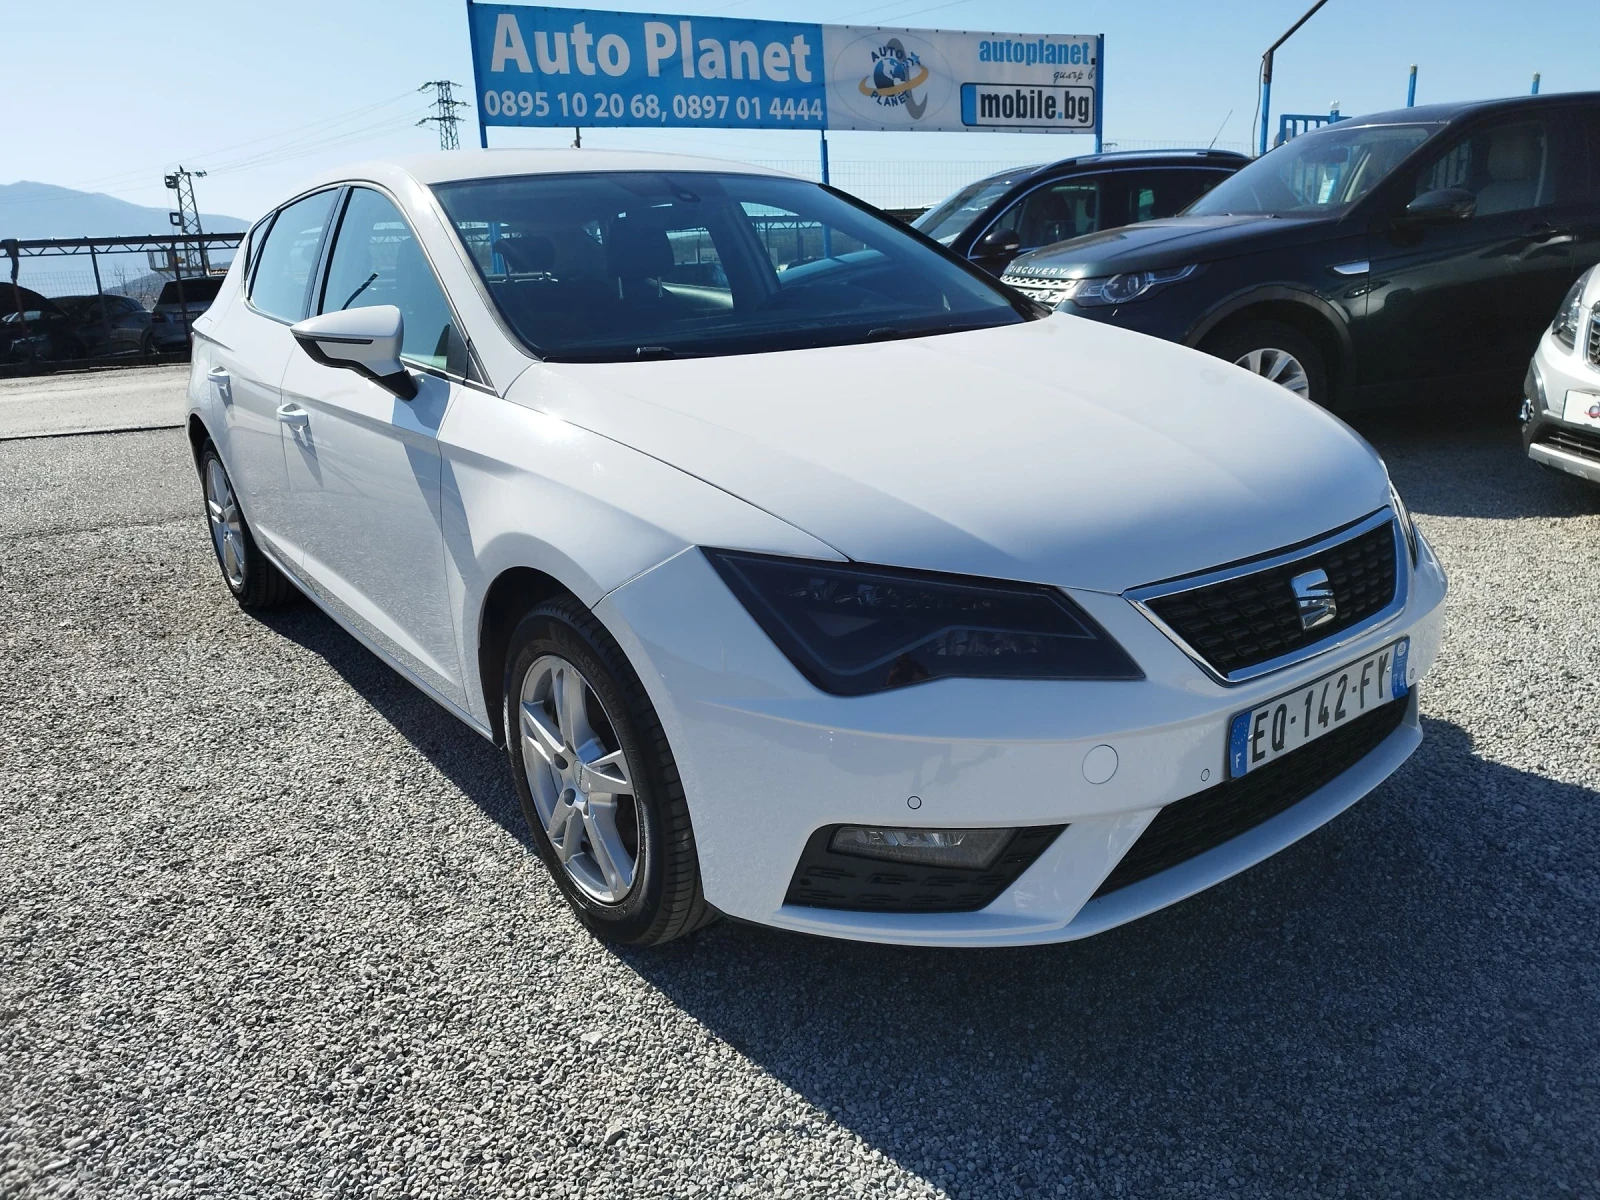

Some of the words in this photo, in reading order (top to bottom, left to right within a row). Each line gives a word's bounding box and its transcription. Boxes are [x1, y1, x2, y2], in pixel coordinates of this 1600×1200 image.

[490, 13, 631, 77] Auto
[643, 20, 812, 83] Planet
[871, 46, 904, 63] AUTO
[484, 89, 550, 117] 0895
[557, 92, 587, 117] 10
[594, 93, 624, 118] 20
[630, 94, 668, 122] 68,
[672, 94, 730, 119] 0897
[736, 96, 761, 120] 01
[769, 98, 824, 121] 4444
[980, 89, 1089, 123] mobile.bg
[1008, 265, 1068, 276] DISCOVERY
[1252, 652, 1389, 763] EQ-142-FY
[1235, 752, 1242, 768] F
